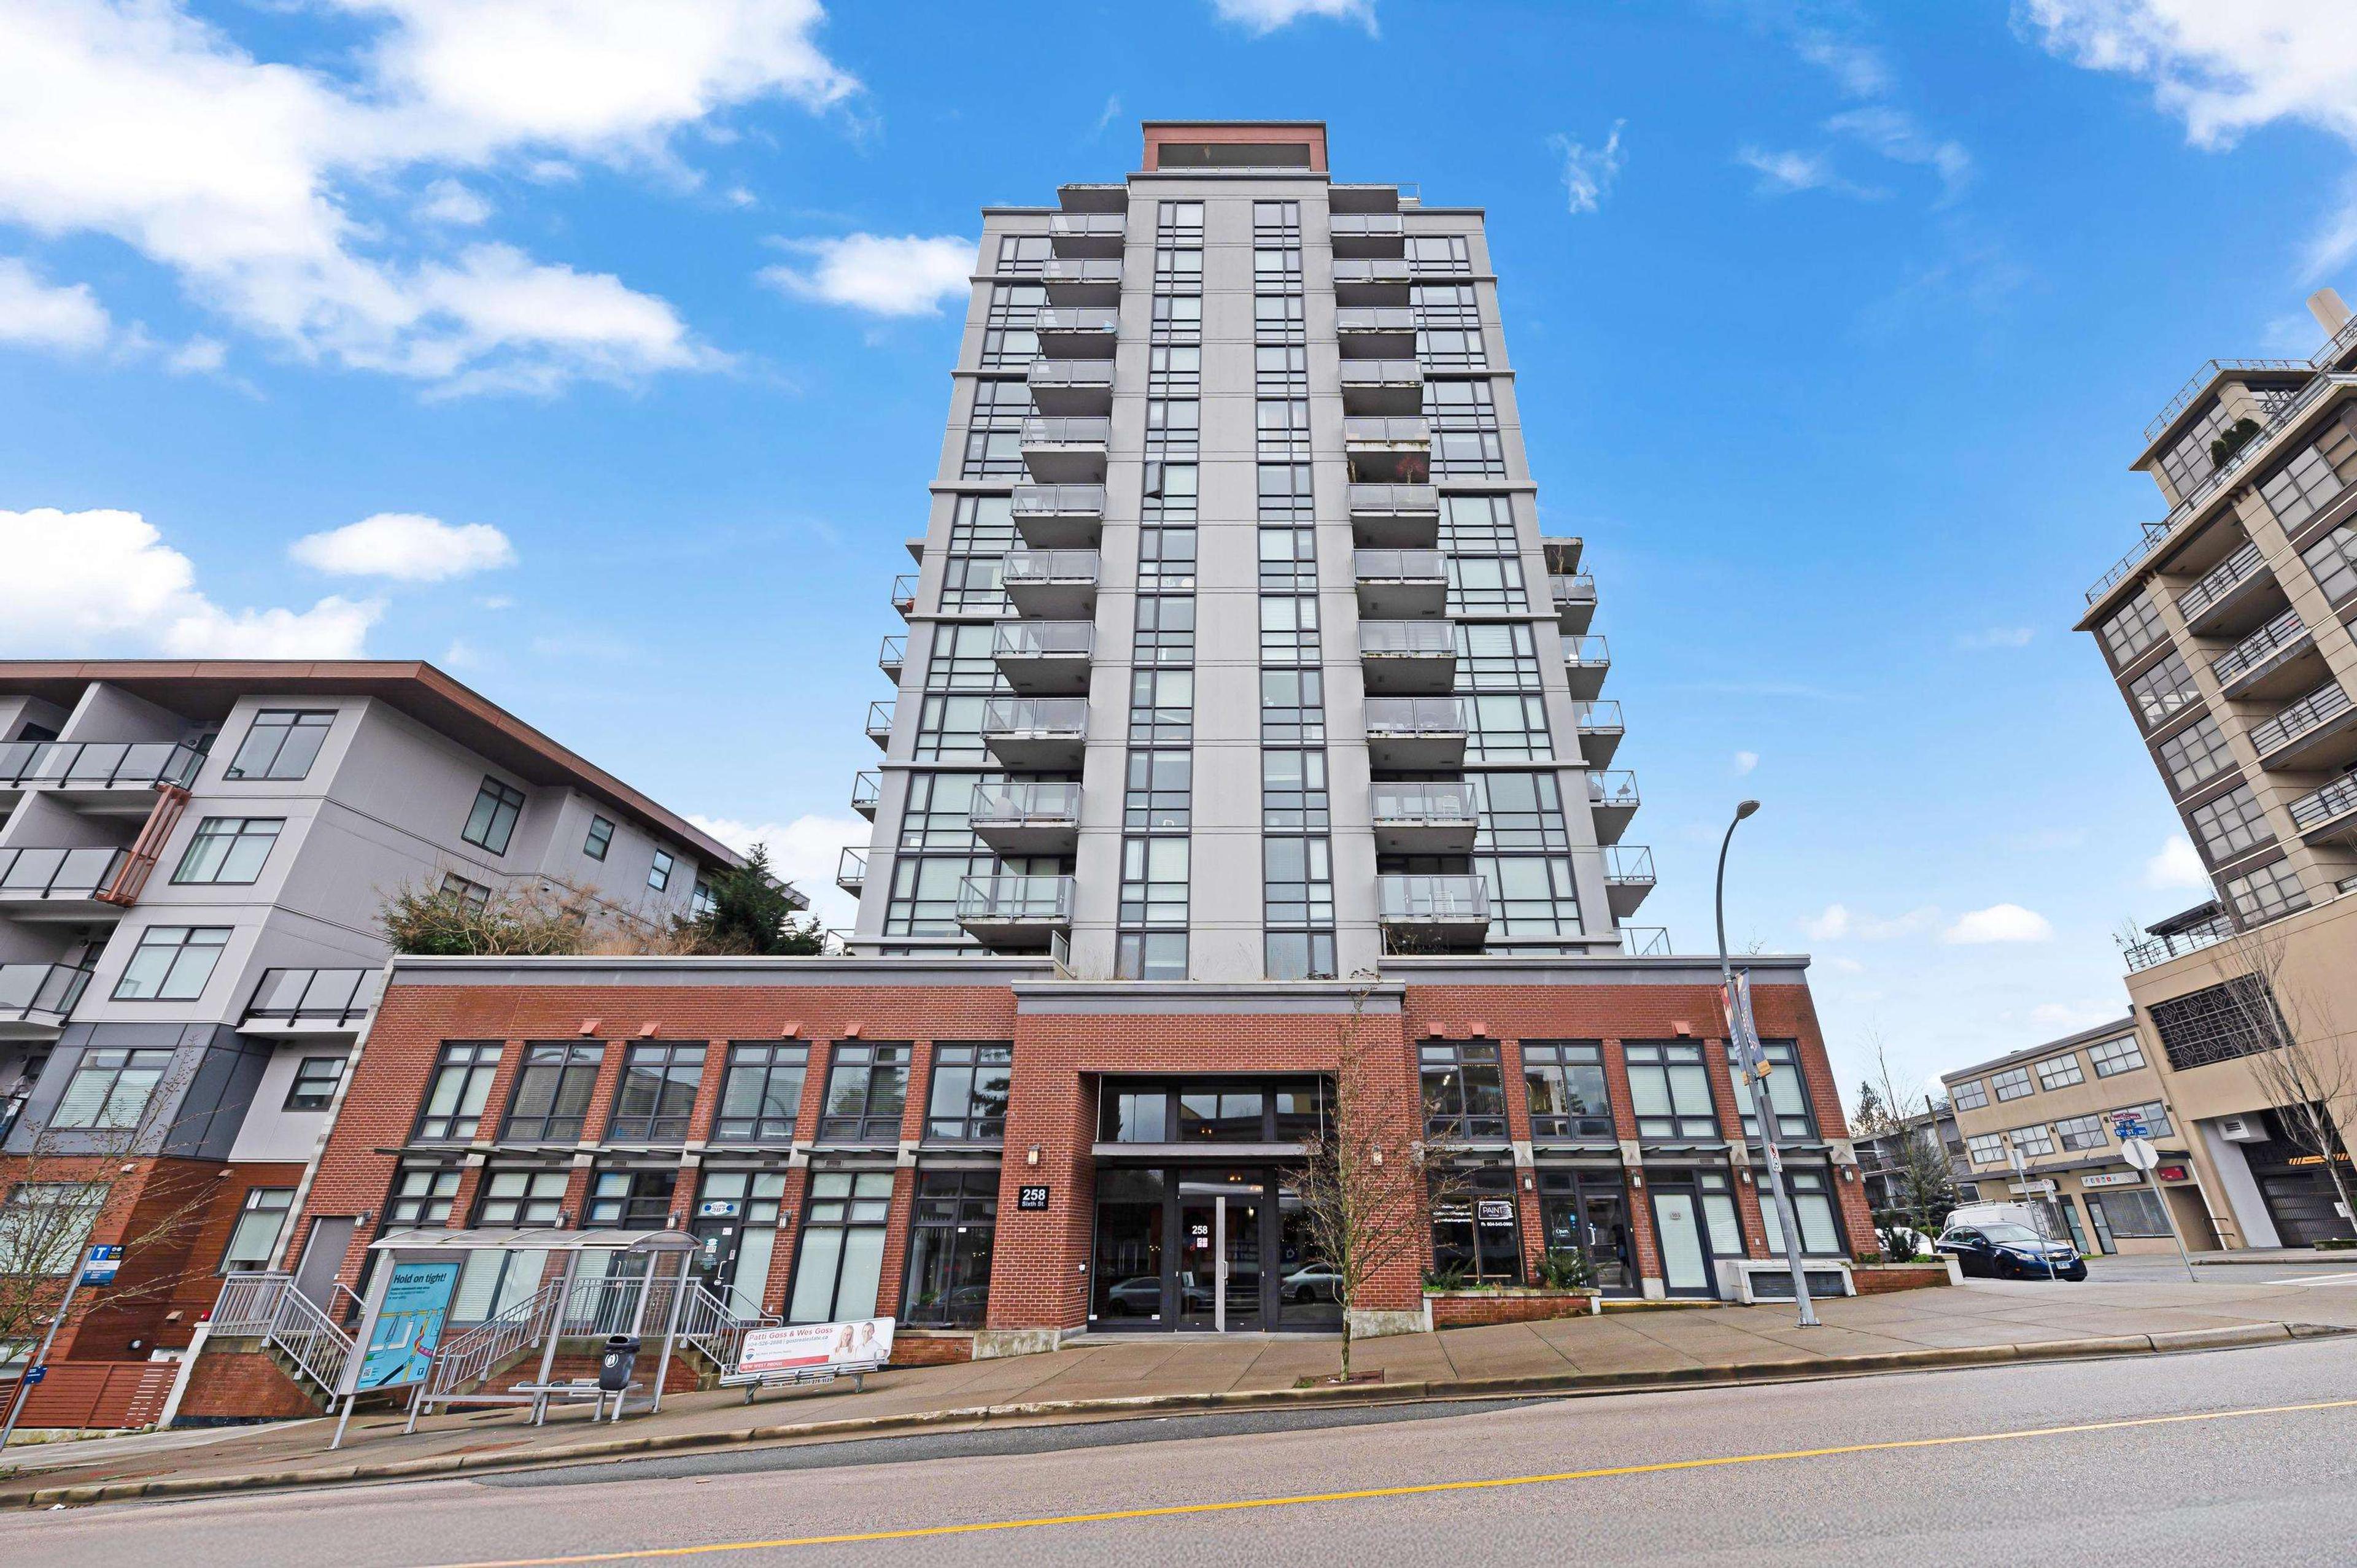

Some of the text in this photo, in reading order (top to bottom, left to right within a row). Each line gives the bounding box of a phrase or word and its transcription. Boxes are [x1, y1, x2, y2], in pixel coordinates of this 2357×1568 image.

[1023, 1189, 1046, 1200] 258
[1192, 1225, 1208, 1234] 258
[96, 1247, 108, 1259] T
[393, 1273, 447, 1284] Hold on tight!
[749, 1333, 767, 1342] Patti
[785, 1335, 829, 1345] gossrealestate.ca
